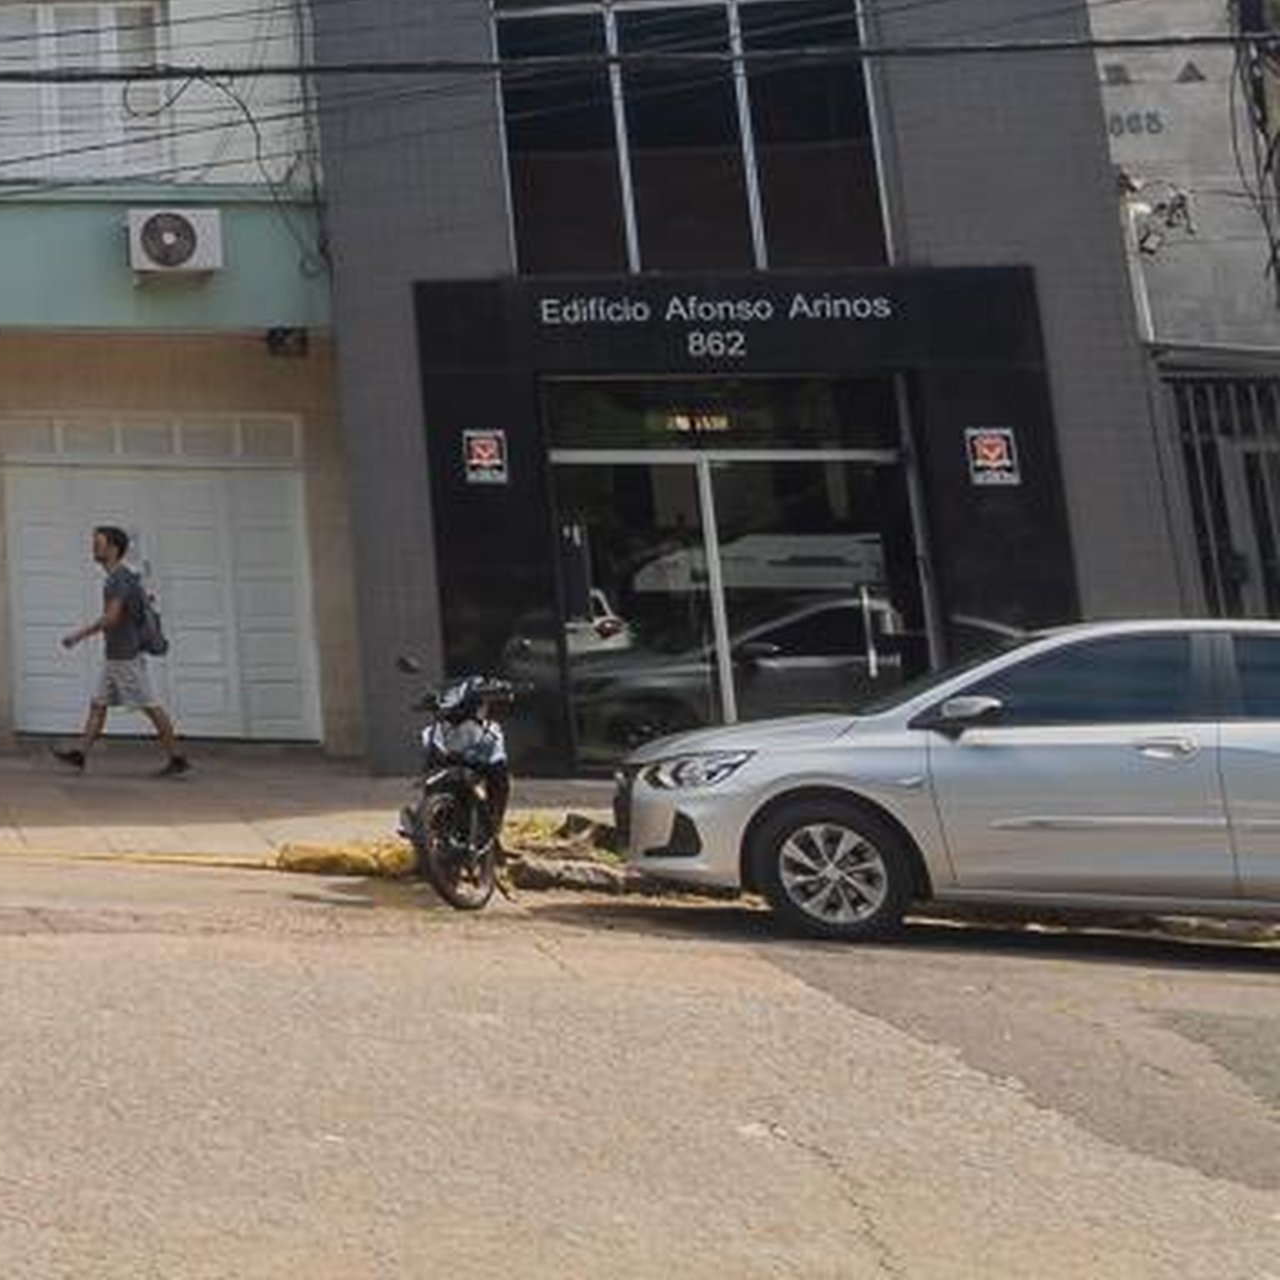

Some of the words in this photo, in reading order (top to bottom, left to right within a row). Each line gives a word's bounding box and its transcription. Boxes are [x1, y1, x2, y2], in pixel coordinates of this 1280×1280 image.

[665, 293, 774, 322] Afonso
[788, 291, 892, 320] Arinos
[687, 330, 747, 357] 862
